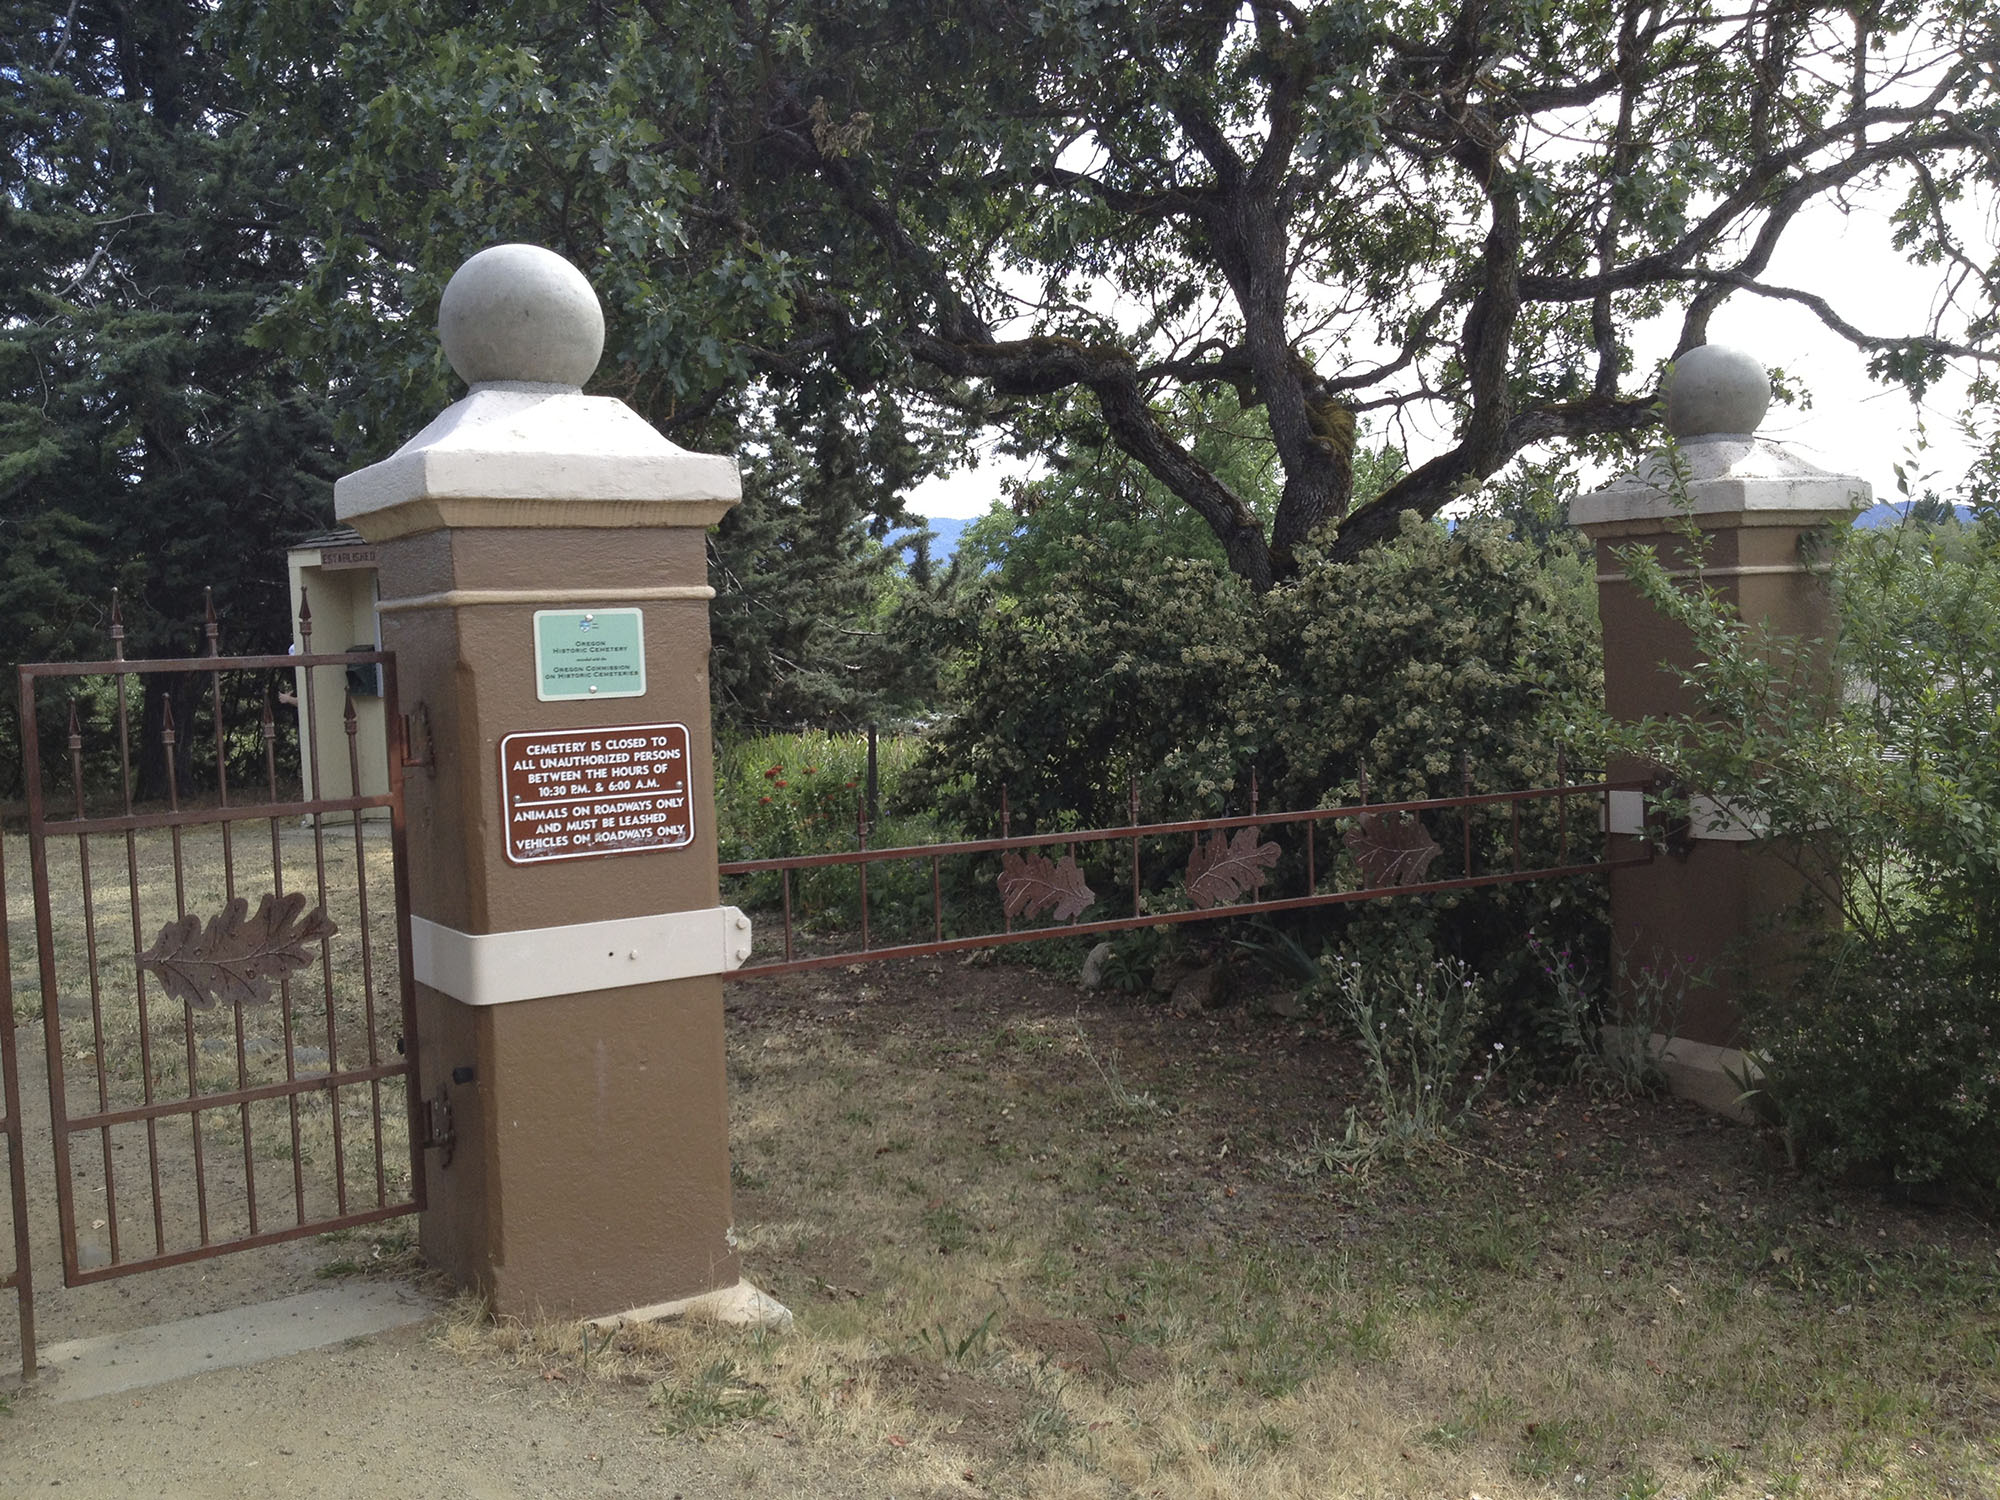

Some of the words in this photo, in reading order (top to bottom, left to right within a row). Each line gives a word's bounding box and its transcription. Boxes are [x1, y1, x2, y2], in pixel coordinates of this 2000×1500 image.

[526, 741, 587, 756] CEMETERY
[591, 741, 601, 751] IS
[605, 738, 647, 750] CLOSED
[651, 736, 667, 747] TO
[513, 760, 535, 771] ALL
[540, 752, 630, 769] UNAUTHORIZED
[634, 749, 681, 762] PERSONS
[528, 771, 581, 784] BETWEEN
[585, 768, 608, 779] THE
[611, 765, 649, 777] HOURS
[653, 764, 668, 774] OF
[538, 785, 567, 798] 10:30
[595, 782, 604, 793] &
[609, 780, 631, 792] 6:00
[635, 778, 660, 790] A.M.
[514, 807, 568, 822] ANIMALS
[572, 805, 590, 817] ON
[594, 799, 652, 815] ROADWAYS
[656, 797, 684, 809] ONLY
[536, 822, 562, 835] AND
[566, 818, 598, 832] MUST
[602, 816, 616, 827] BE
[619, 813, 667, 826] LEASHED
[516, 835, 569, 851] VEHICLES
[573, 833, 590, 845] ON
[594, 827, 653, 843] ROADWAYS
[657, 824, 685, 836] ONLY
